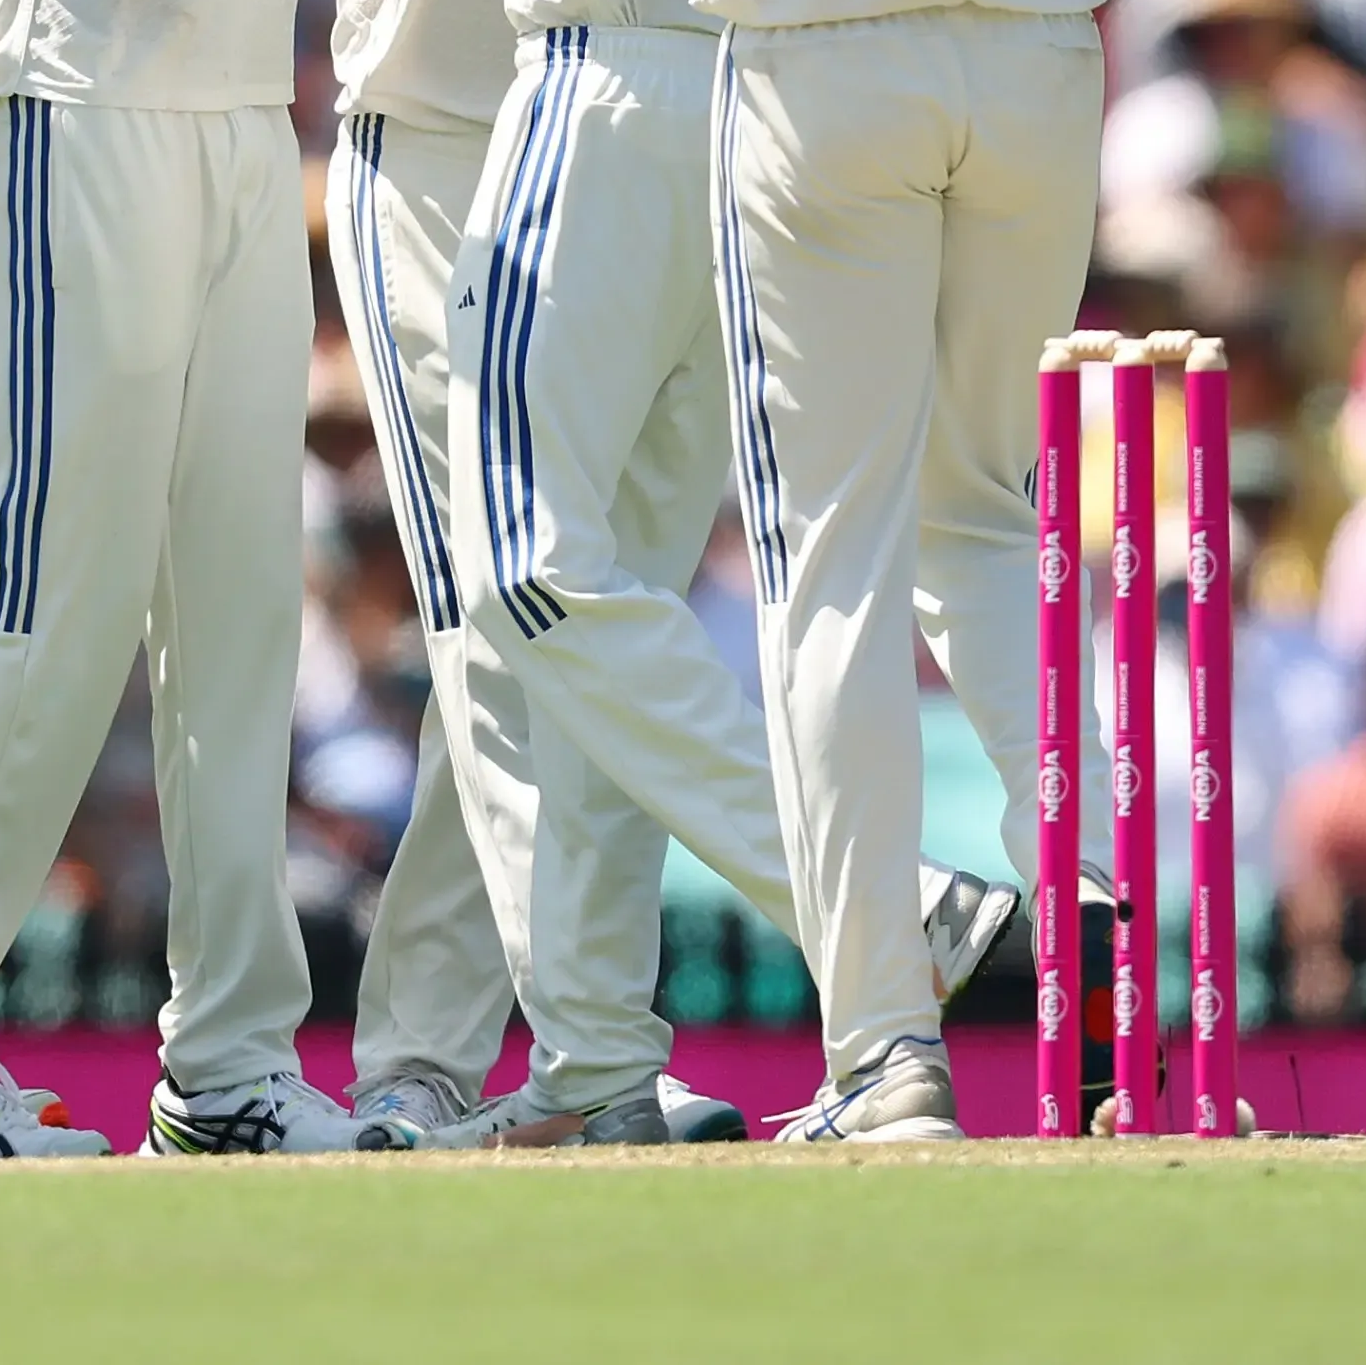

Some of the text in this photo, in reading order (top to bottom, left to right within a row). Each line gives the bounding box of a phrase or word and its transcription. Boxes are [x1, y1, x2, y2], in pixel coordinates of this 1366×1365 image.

[1044, 446, 1062, 604] NRMA INSURANCE
[1115, 441, 1132, 599] NRMA INSURANCE
[1191, 445, 1209, 605] NRMA INSURANCE
[1043, 666, 1062, 823] NRMA INSURANCE
[1116, 661, 1133, 818] NRMA INSURANCE
[1194, 665, 1212, 823] NRMA INSURANCE
[1042, 884, 1060, 1043] NRMA INSURANCE
[1196, 884, 1215, 1042] NRMA INSURANCE
